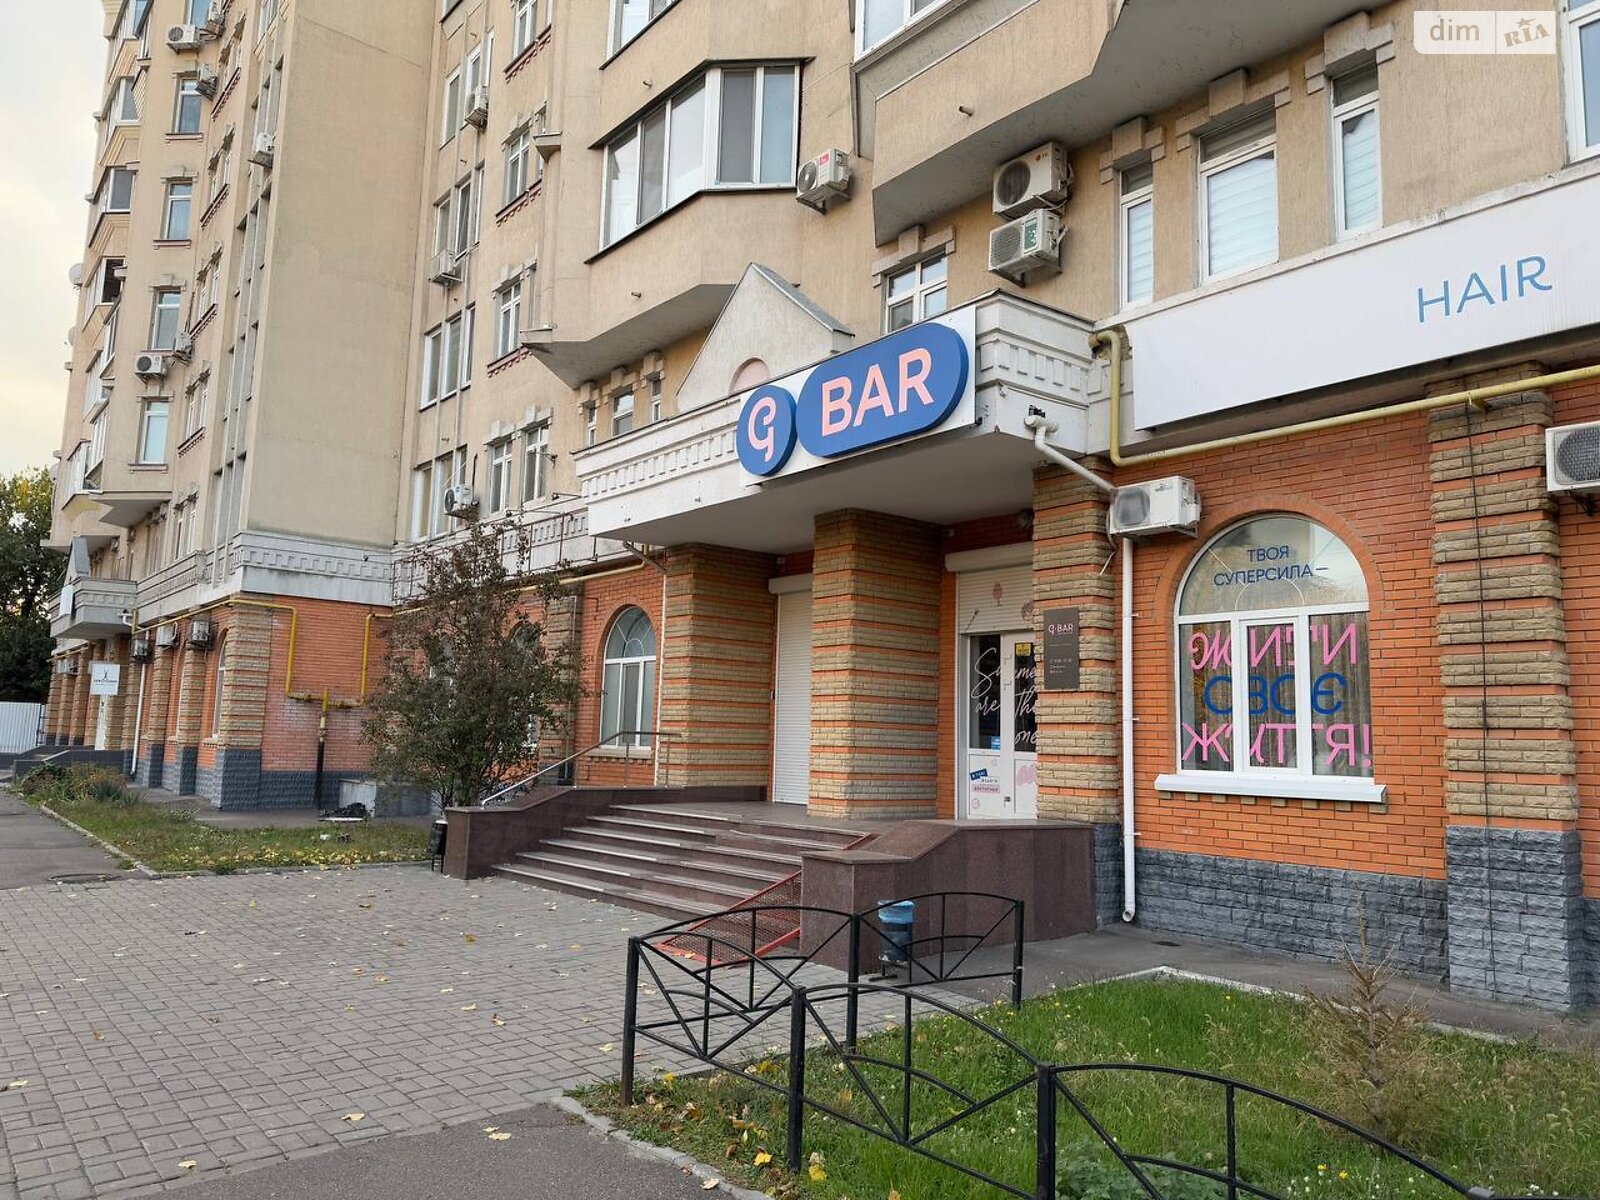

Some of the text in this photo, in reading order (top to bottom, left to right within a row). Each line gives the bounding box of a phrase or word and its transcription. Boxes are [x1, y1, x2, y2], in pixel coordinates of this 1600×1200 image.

[1417, 255, 1553, 323] HAIR
[821, 348, 934, 437] BAR
[1246, 545, 1289, 562] ТВОЯ
